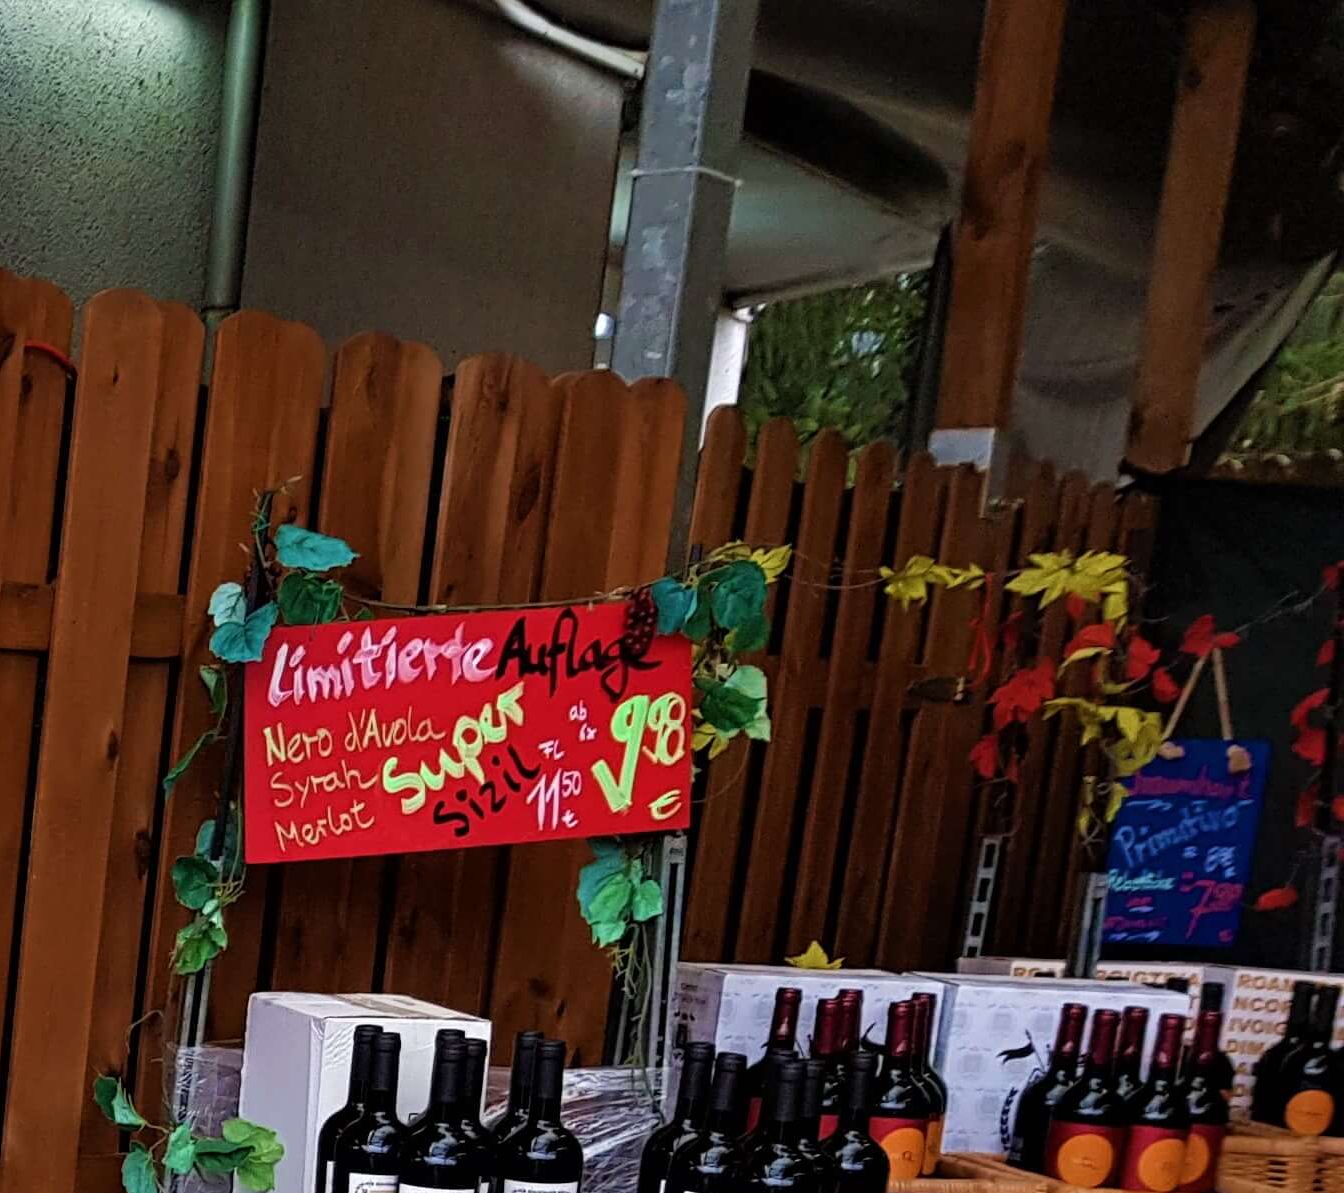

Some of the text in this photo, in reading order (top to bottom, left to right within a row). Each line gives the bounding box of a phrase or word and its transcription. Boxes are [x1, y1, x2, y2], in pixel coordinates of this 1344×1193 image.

[267, 608, 661, 708] Limitierte Auflage
[263, 707, 447, 768] Nero d'Avola
[382, 681, 525, 815] Super
[270, 760, 378, 808] Syrah
[275, 799, 376, 852] Merlot
